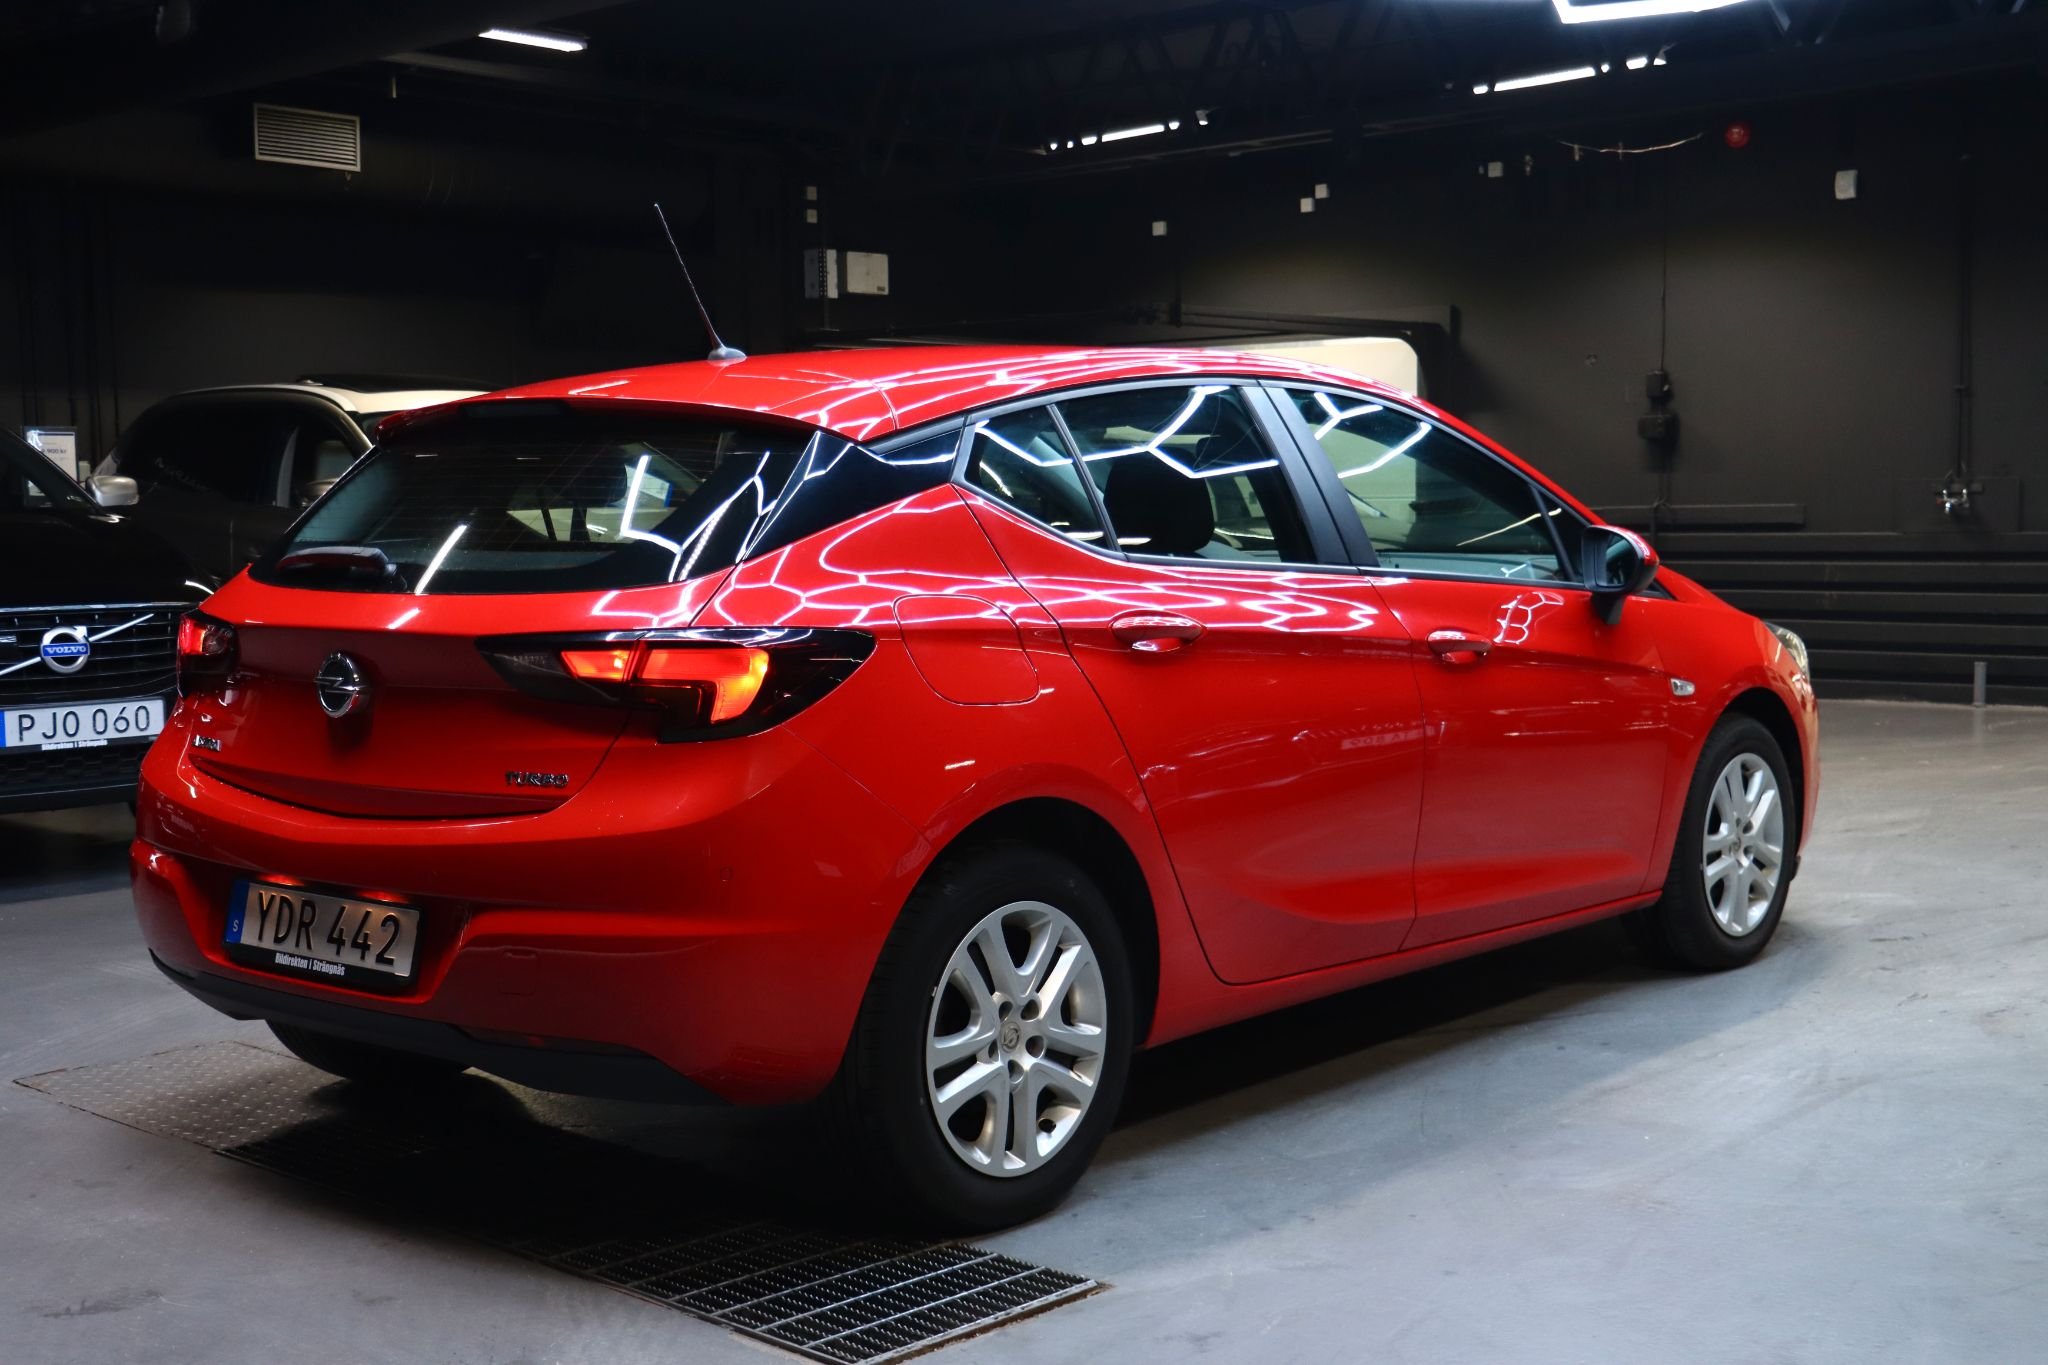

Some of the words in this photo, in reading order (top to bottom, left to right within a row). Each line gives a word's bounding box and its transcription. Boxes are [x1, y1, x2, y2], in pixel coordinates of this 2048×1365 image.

[45, 646, 86, 654] VOLVO
[92, 705, 150, 735] 060
[232, 919, 240, 932] S
[257, 890, 317, 951] YDR
[326, 904, 400, 966] 442
